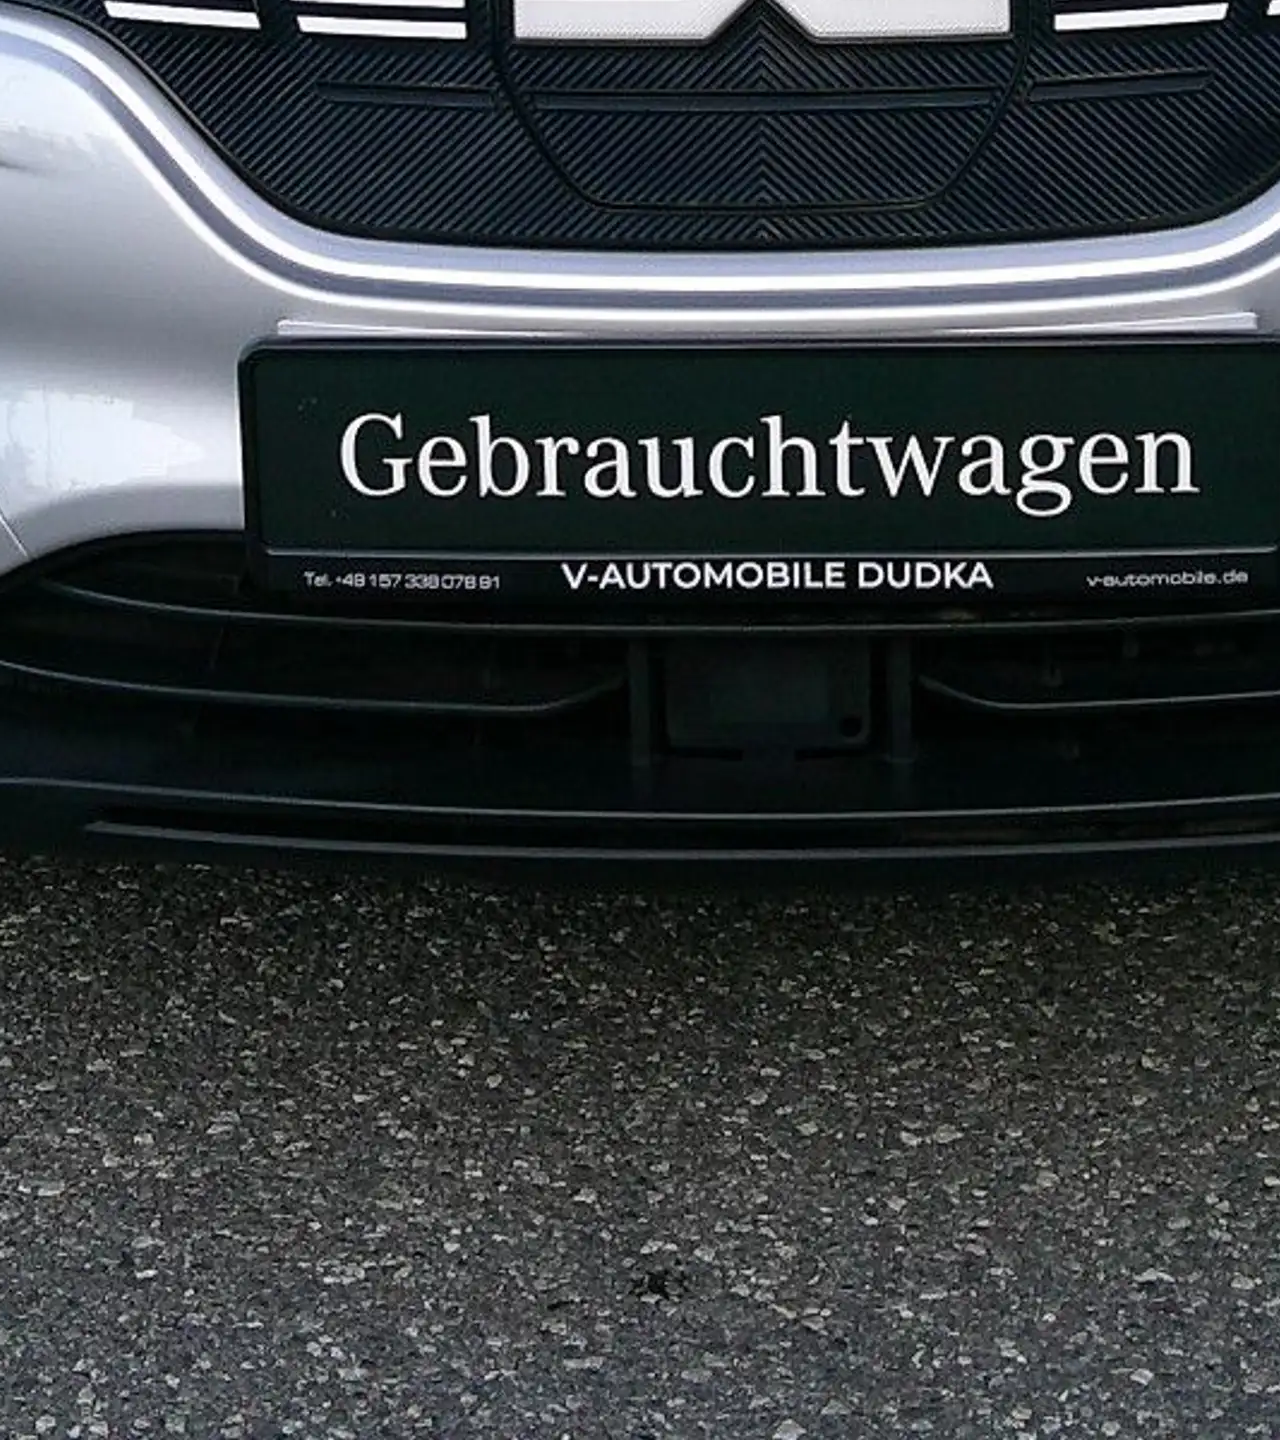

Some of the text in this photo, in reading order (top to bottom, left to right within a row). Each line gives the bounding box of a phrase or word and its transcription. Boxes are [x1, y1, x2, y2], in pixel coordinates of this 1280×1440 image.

[340, 413, 1200, 518] Gebrauchtwagen
[303, 570, 333, 587] Tel.
[561, 561, 994, 590] V-AUTOMOBILE DUDKA
[1086, 569, 1249, 587] v-automobile.de
